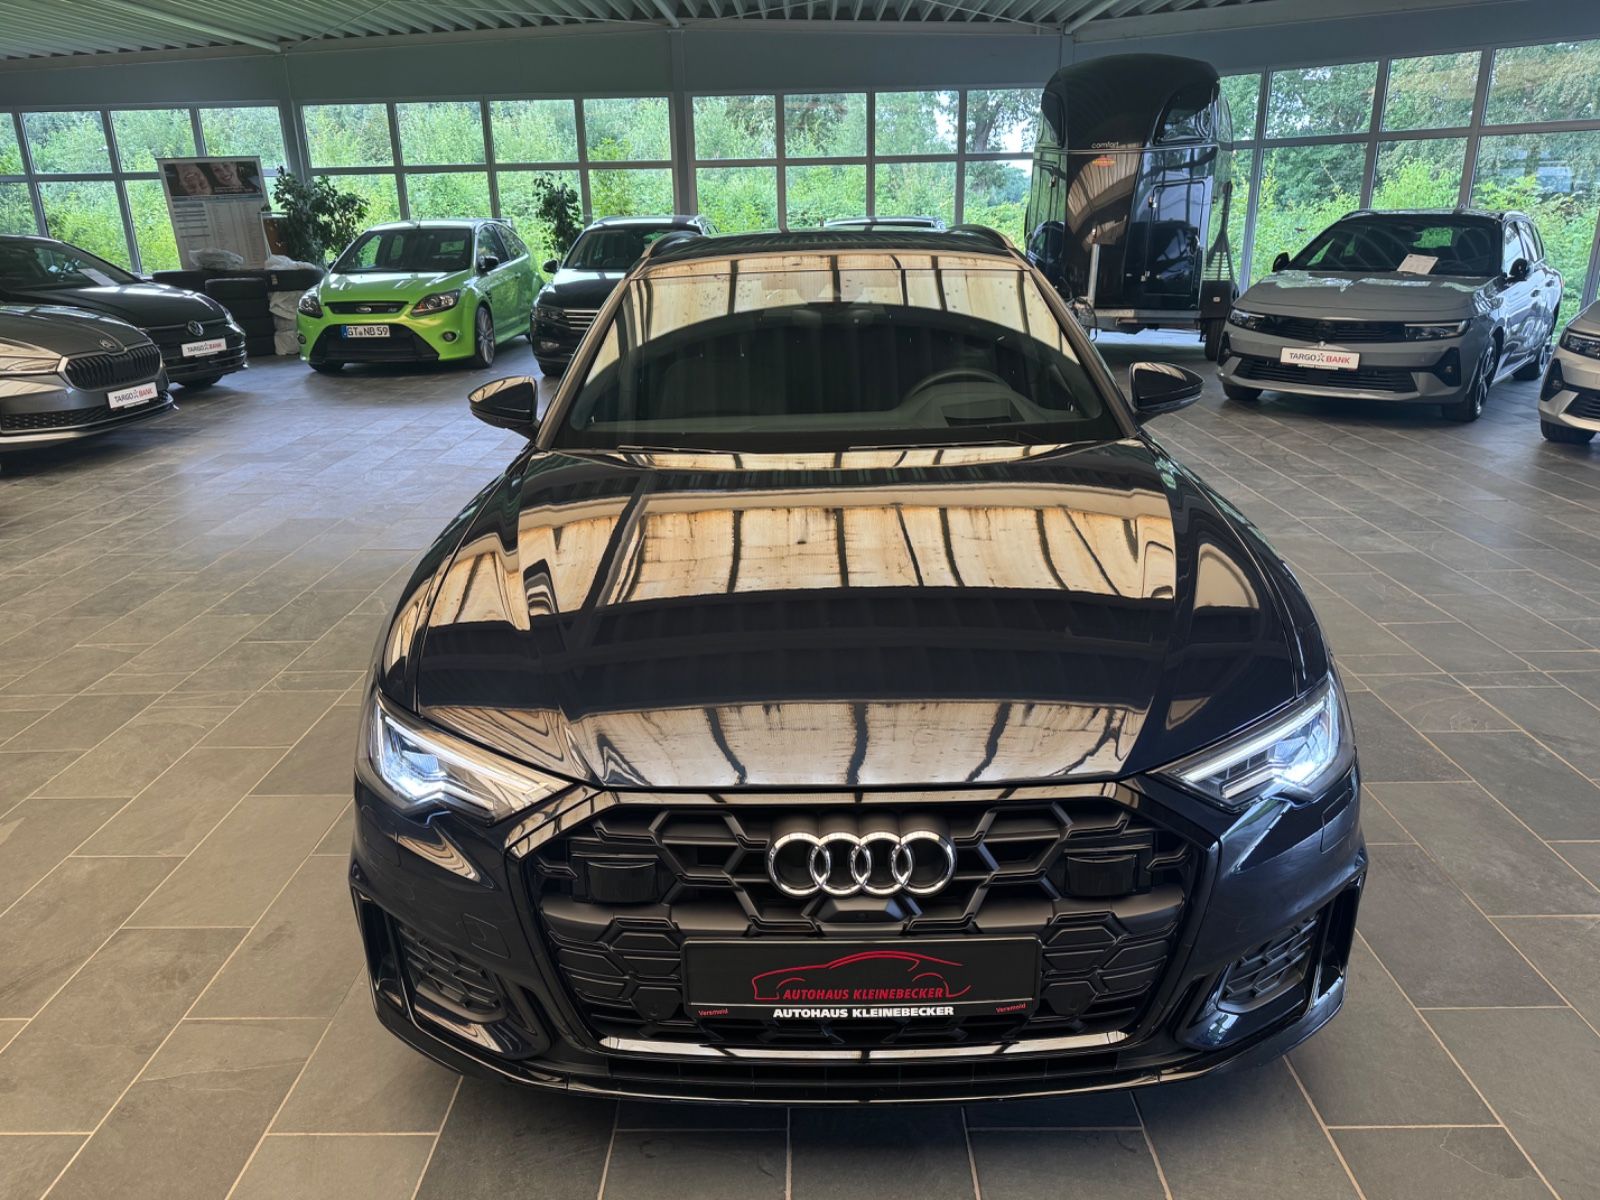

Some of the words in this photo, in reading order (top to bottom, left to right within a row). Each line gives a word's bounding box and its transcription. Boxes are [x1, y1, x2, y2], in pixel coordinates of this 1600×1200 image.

[1091, 141, 1119, 149] comfort
[377, 326, 389, 336] 59
[783, 988, 849, 1000] AUTOHAUS
[853, 987, 944, 1000] KLEINEBECKER
[773, 1008, 848, 1018] AUTOHAUS
[852, 1006, 954, 1018] KLEINEBECKER
